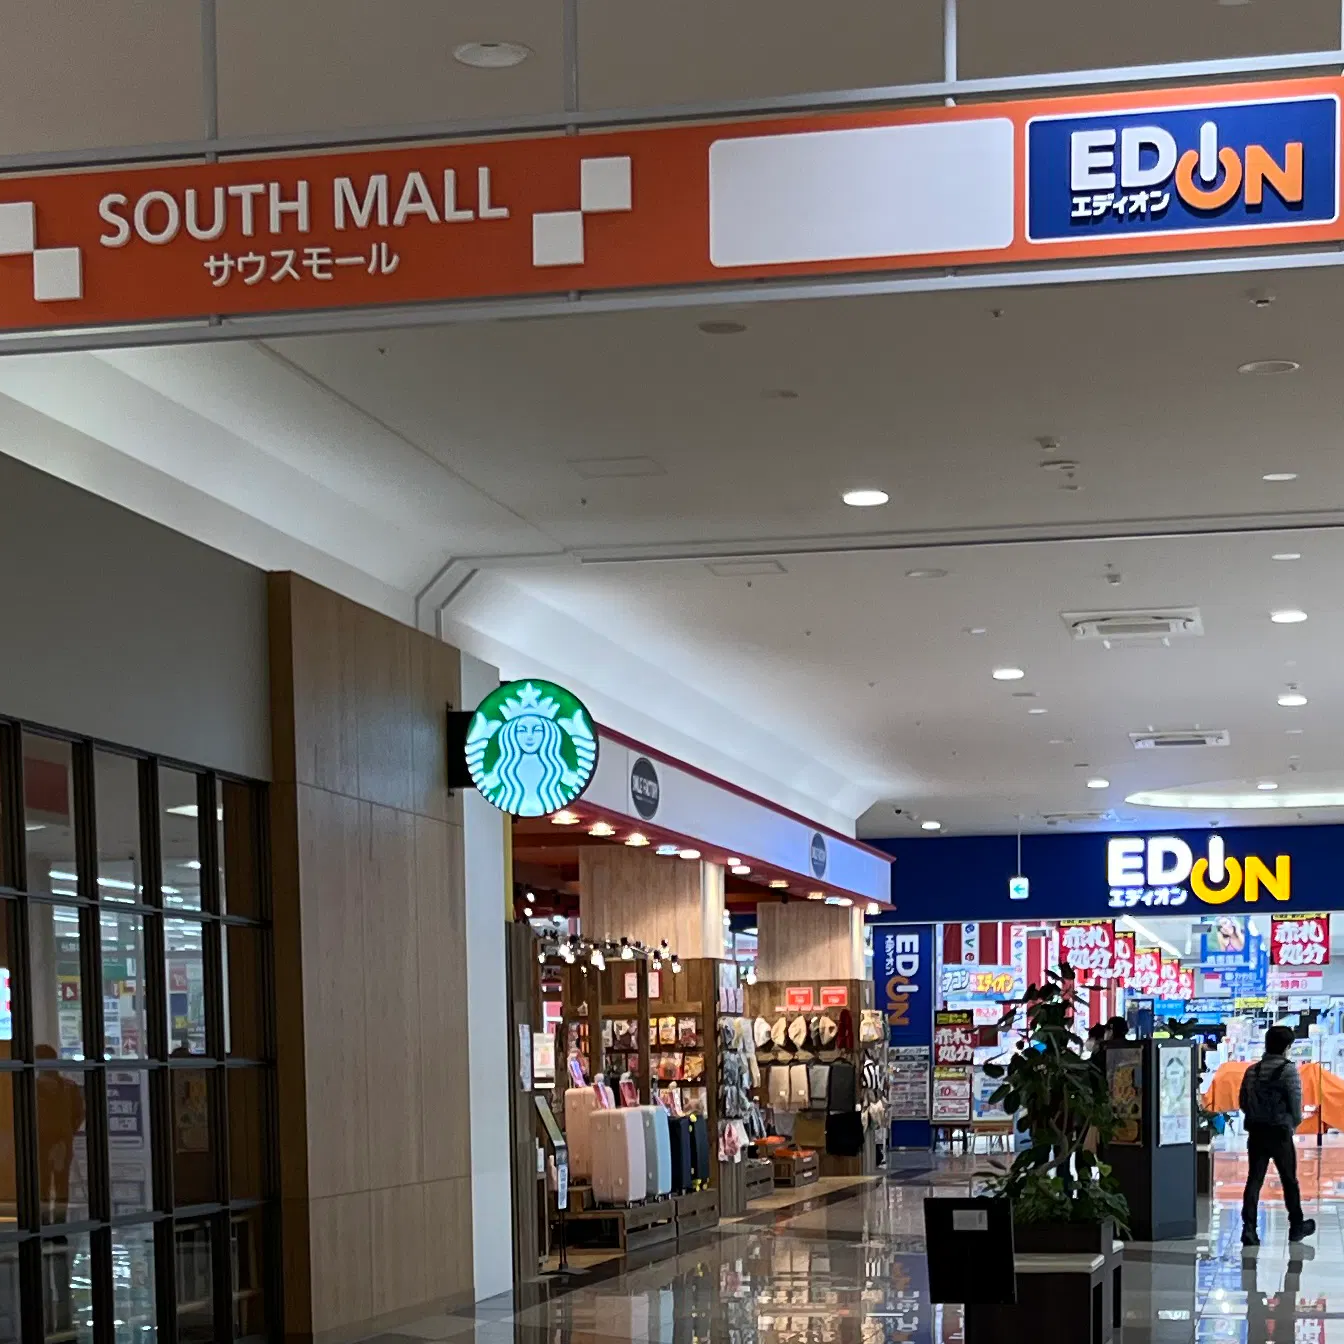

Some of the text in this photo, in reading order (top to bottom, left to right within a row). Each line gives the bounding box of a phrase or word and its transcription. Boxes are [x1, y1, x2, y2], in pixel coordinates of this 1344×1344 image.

[1069, 119, 1304, 212] EDION
[98, 166, 511, 249] SOUTH MALL
[1070, 191, 1171, 219] エディオン
[203, 241, 401, 288] サウスモール
[1107, 834, 1291, 905] EDION
[1108, 887, 1187, 907] エディオン
[1062, 926, 1110, 949] 赤札
[1275, 920, 1324, 944] 赤札
[1066, 948, 1113, 969] 処分
[1279, 943, 1327, 966] 処分
[934, 1027, 972, 1044] 赤札
